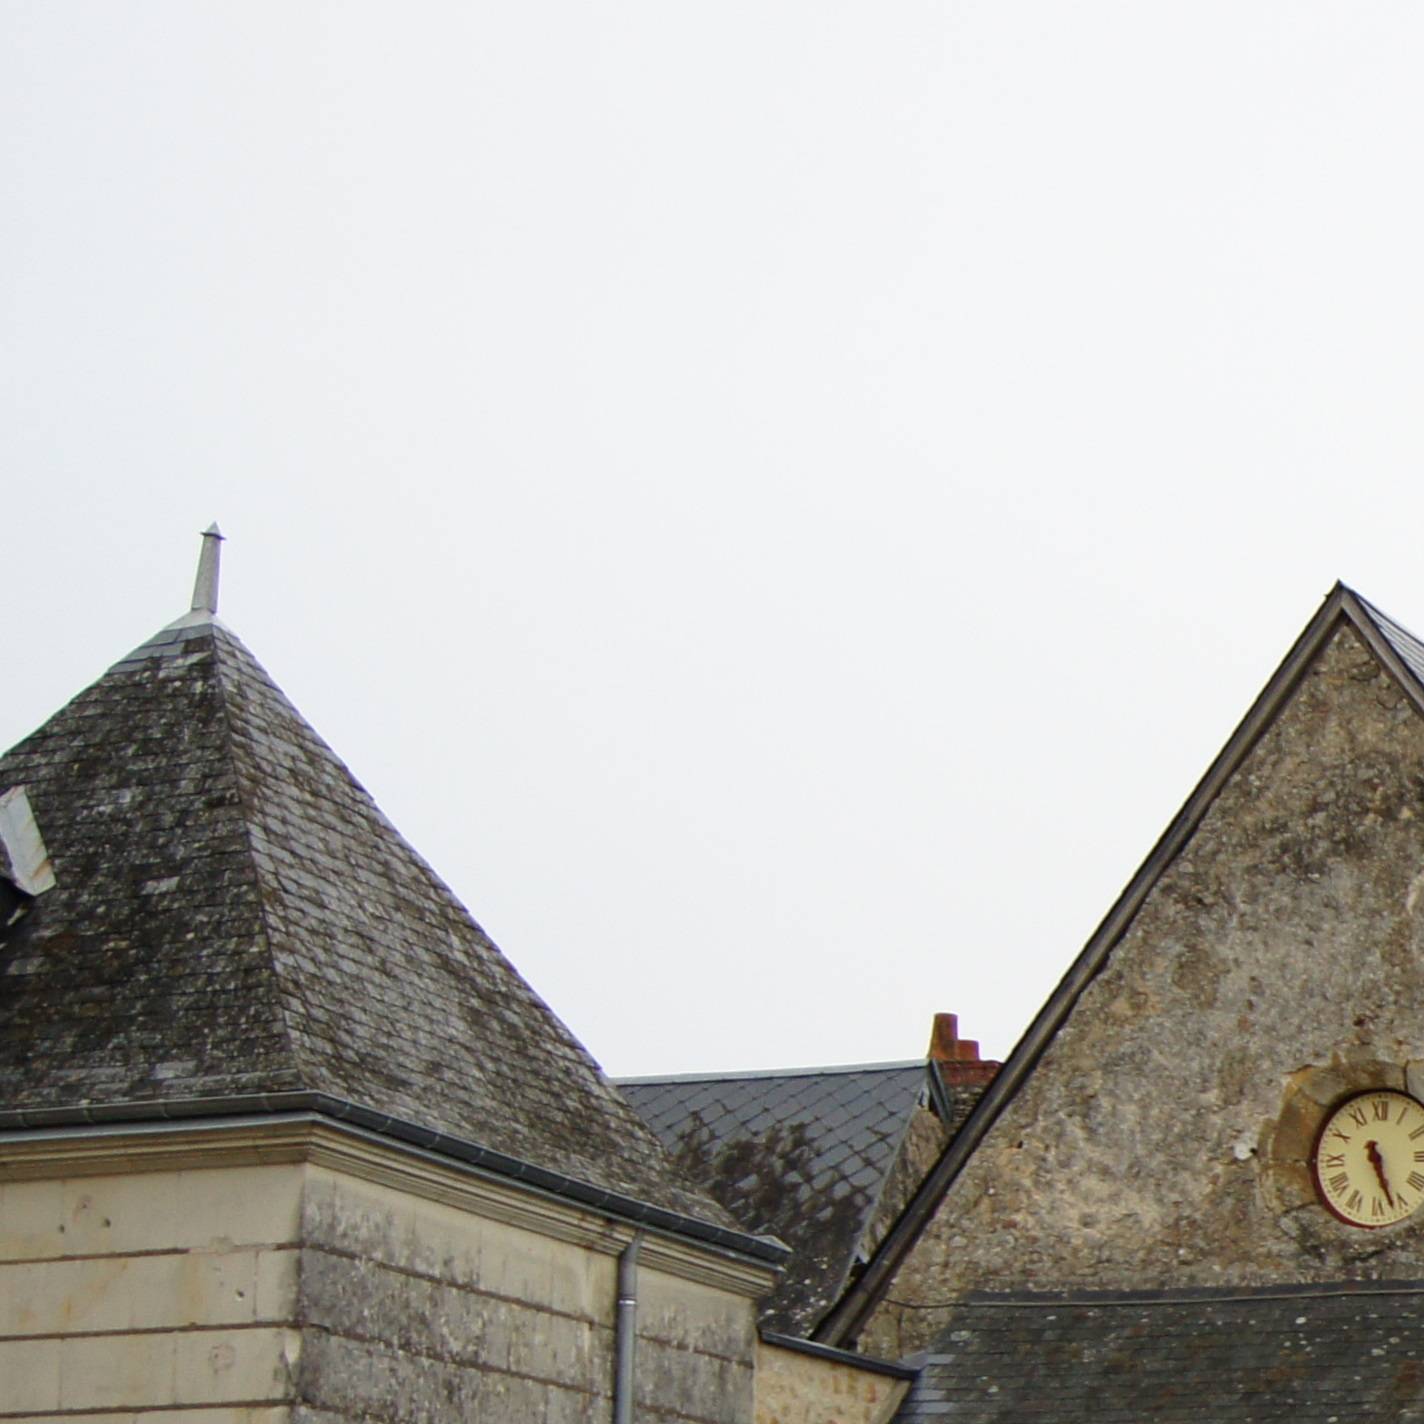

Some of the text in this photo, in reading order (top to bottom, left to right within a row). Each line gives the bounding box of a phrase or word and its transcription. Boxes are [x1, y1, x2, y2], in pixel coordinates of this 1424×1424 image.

[1349, 1107, 1368, 1129] XI
[1372, 1101, 1389, 1121] XII
[1396, 1107, 1408, 1125] I
[1332, 1128, 1351, 1144] X
[1326, 1154, 1345, 1168] IX
[1396, 1192, 1409, 1210] V
